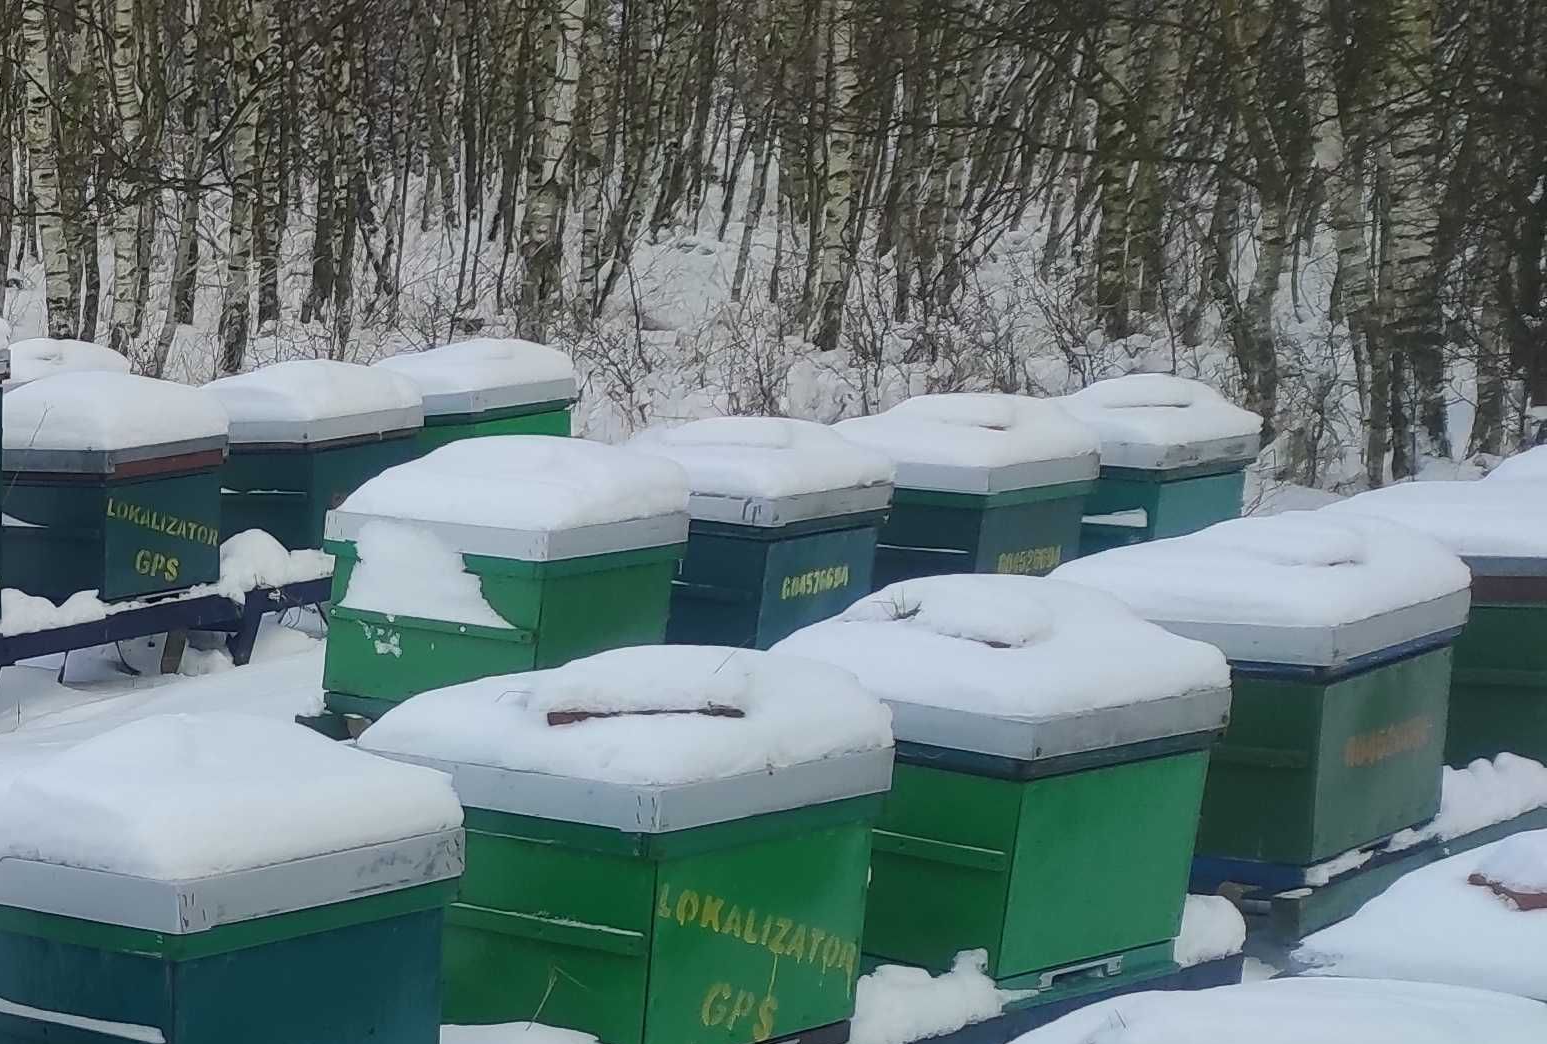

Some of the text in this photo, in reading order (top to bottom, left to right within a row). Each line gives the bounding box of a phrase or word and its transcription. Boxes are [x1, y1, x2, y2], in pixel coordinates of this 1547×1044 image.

[107, 498, 219, 546] LOKALIZATOR
[135, 549, 179, 581] GPS
[658, 883, 857, 972] LOKALIZATOR
[701, 982, 778, 1042] GPS
